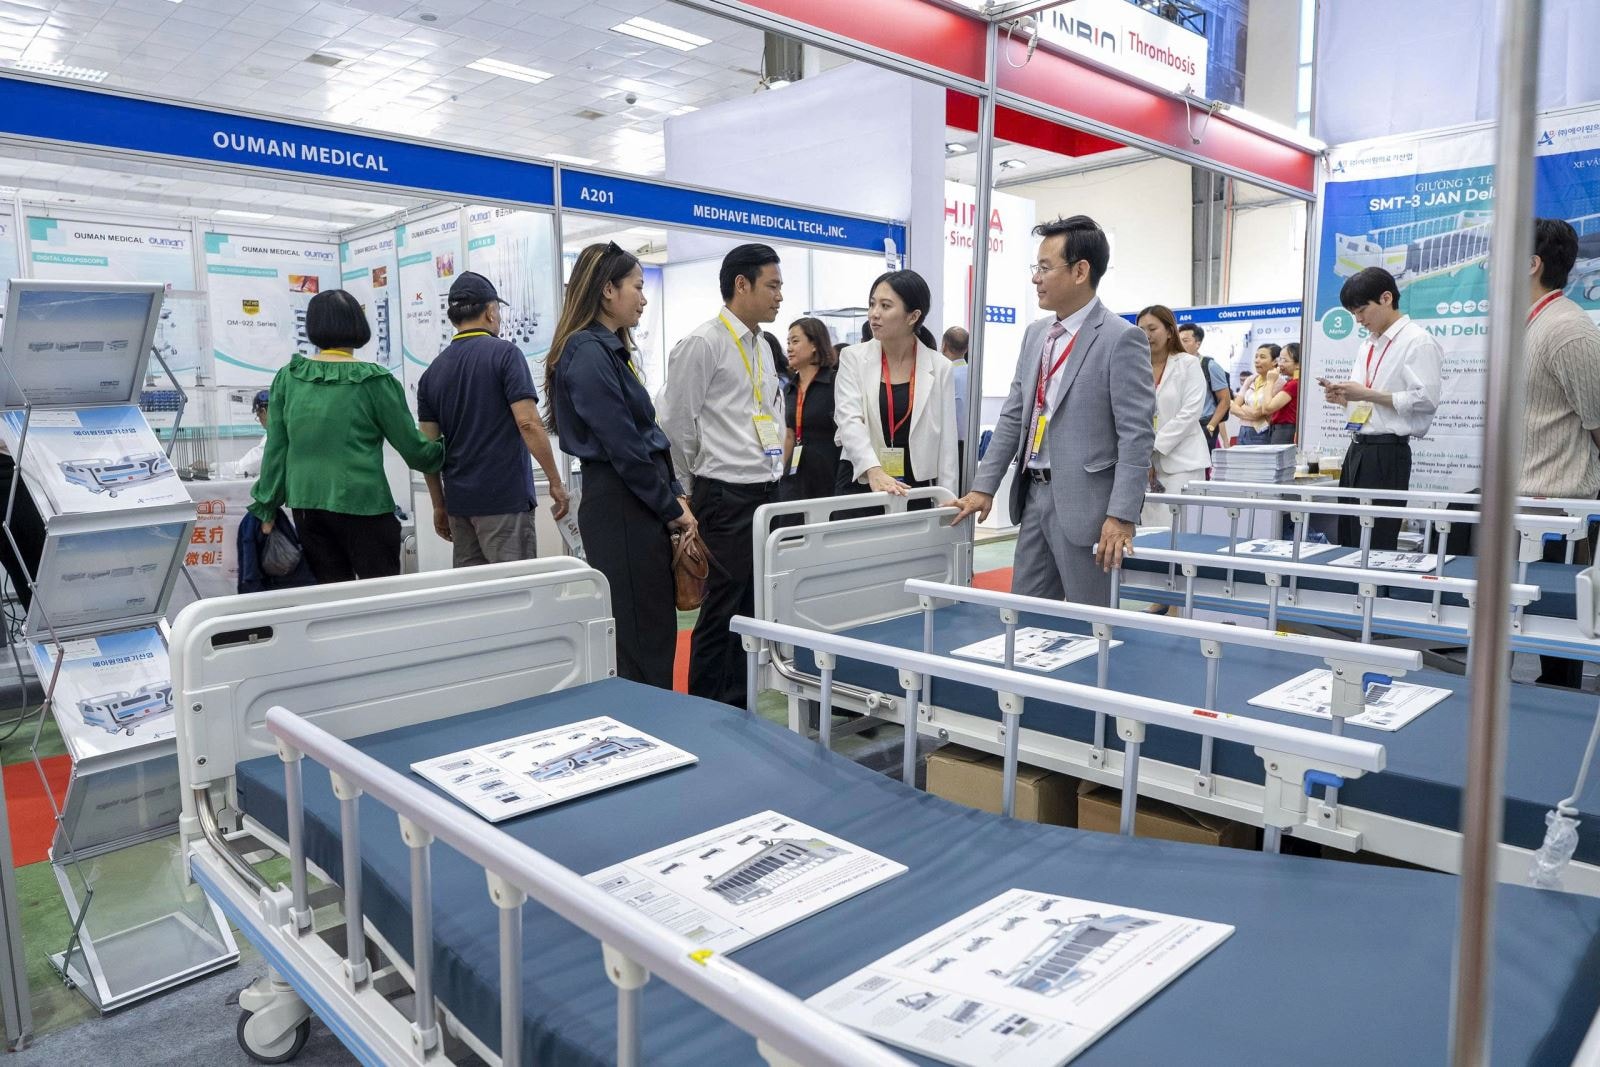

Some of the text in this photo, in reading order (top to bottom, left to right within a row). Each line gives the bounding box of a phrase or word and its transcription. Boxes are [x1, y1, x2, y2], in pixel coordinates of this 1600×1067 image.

[1128, 31, 1196, 76] Thrombosis
[213, 131, 389, 172] OUMAN MEDICAL
[1415, 177, 1463, 192] GIƯỜNG
[1467, 177, 1476, 186] Y
[1369, 194, 1420, 211] SMT-3
[1424, 190, 1461, 206] JAN
[580, 186, 848, 239] A201 MEDHAVE MEDICAL TECH.,INC.
[74, 232, 106, 241] OUMAN
[107, 234, 144, 244] MEDICAL
[950, 230, 976, 248] Sinc
[241, 246, 269, 254] OUMAN
[269, 247, 300, 256] MEDICAL
[1218, 311, 1237, 319] CÔNG
[1237, 310, 1246, 318] TY
[1247, 309, 1266, 317] TNHH
[1286, 306, 1300, 314] TAY
[257, 320, 277, 328] Series
[1334, 316, 1342, 328] 3
[1425, 323, 1488, 336] AN Delu
